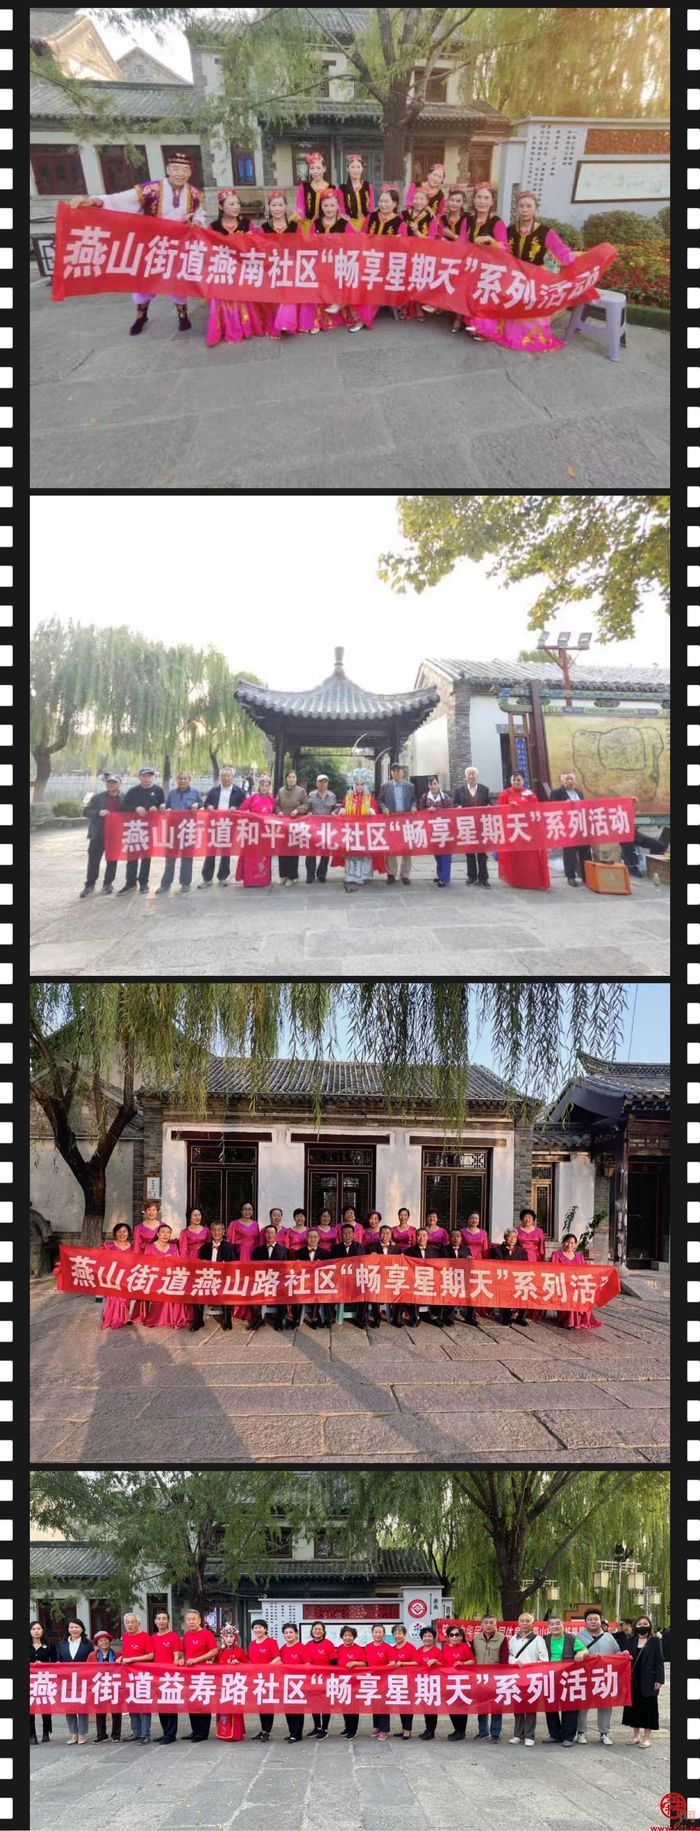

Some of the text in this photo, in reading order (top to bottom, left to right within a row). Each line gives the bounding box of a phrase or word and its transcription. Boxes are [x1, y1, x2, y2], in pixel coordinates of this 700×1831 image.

[63, 226, 600, 310] 燕山街道燕南社区“畅享星期天”系列活动
[121, 805, 630, 852] 燕山街道和平路北社区“畅享星期天”系列活动
[69, 1255, 608, 1304] 燕山街道燕山路社区“畅享星期天”系列活
[30, 1664, 619, 1706] 燕山街道益寿路社区“畅享星期天”系列活动
